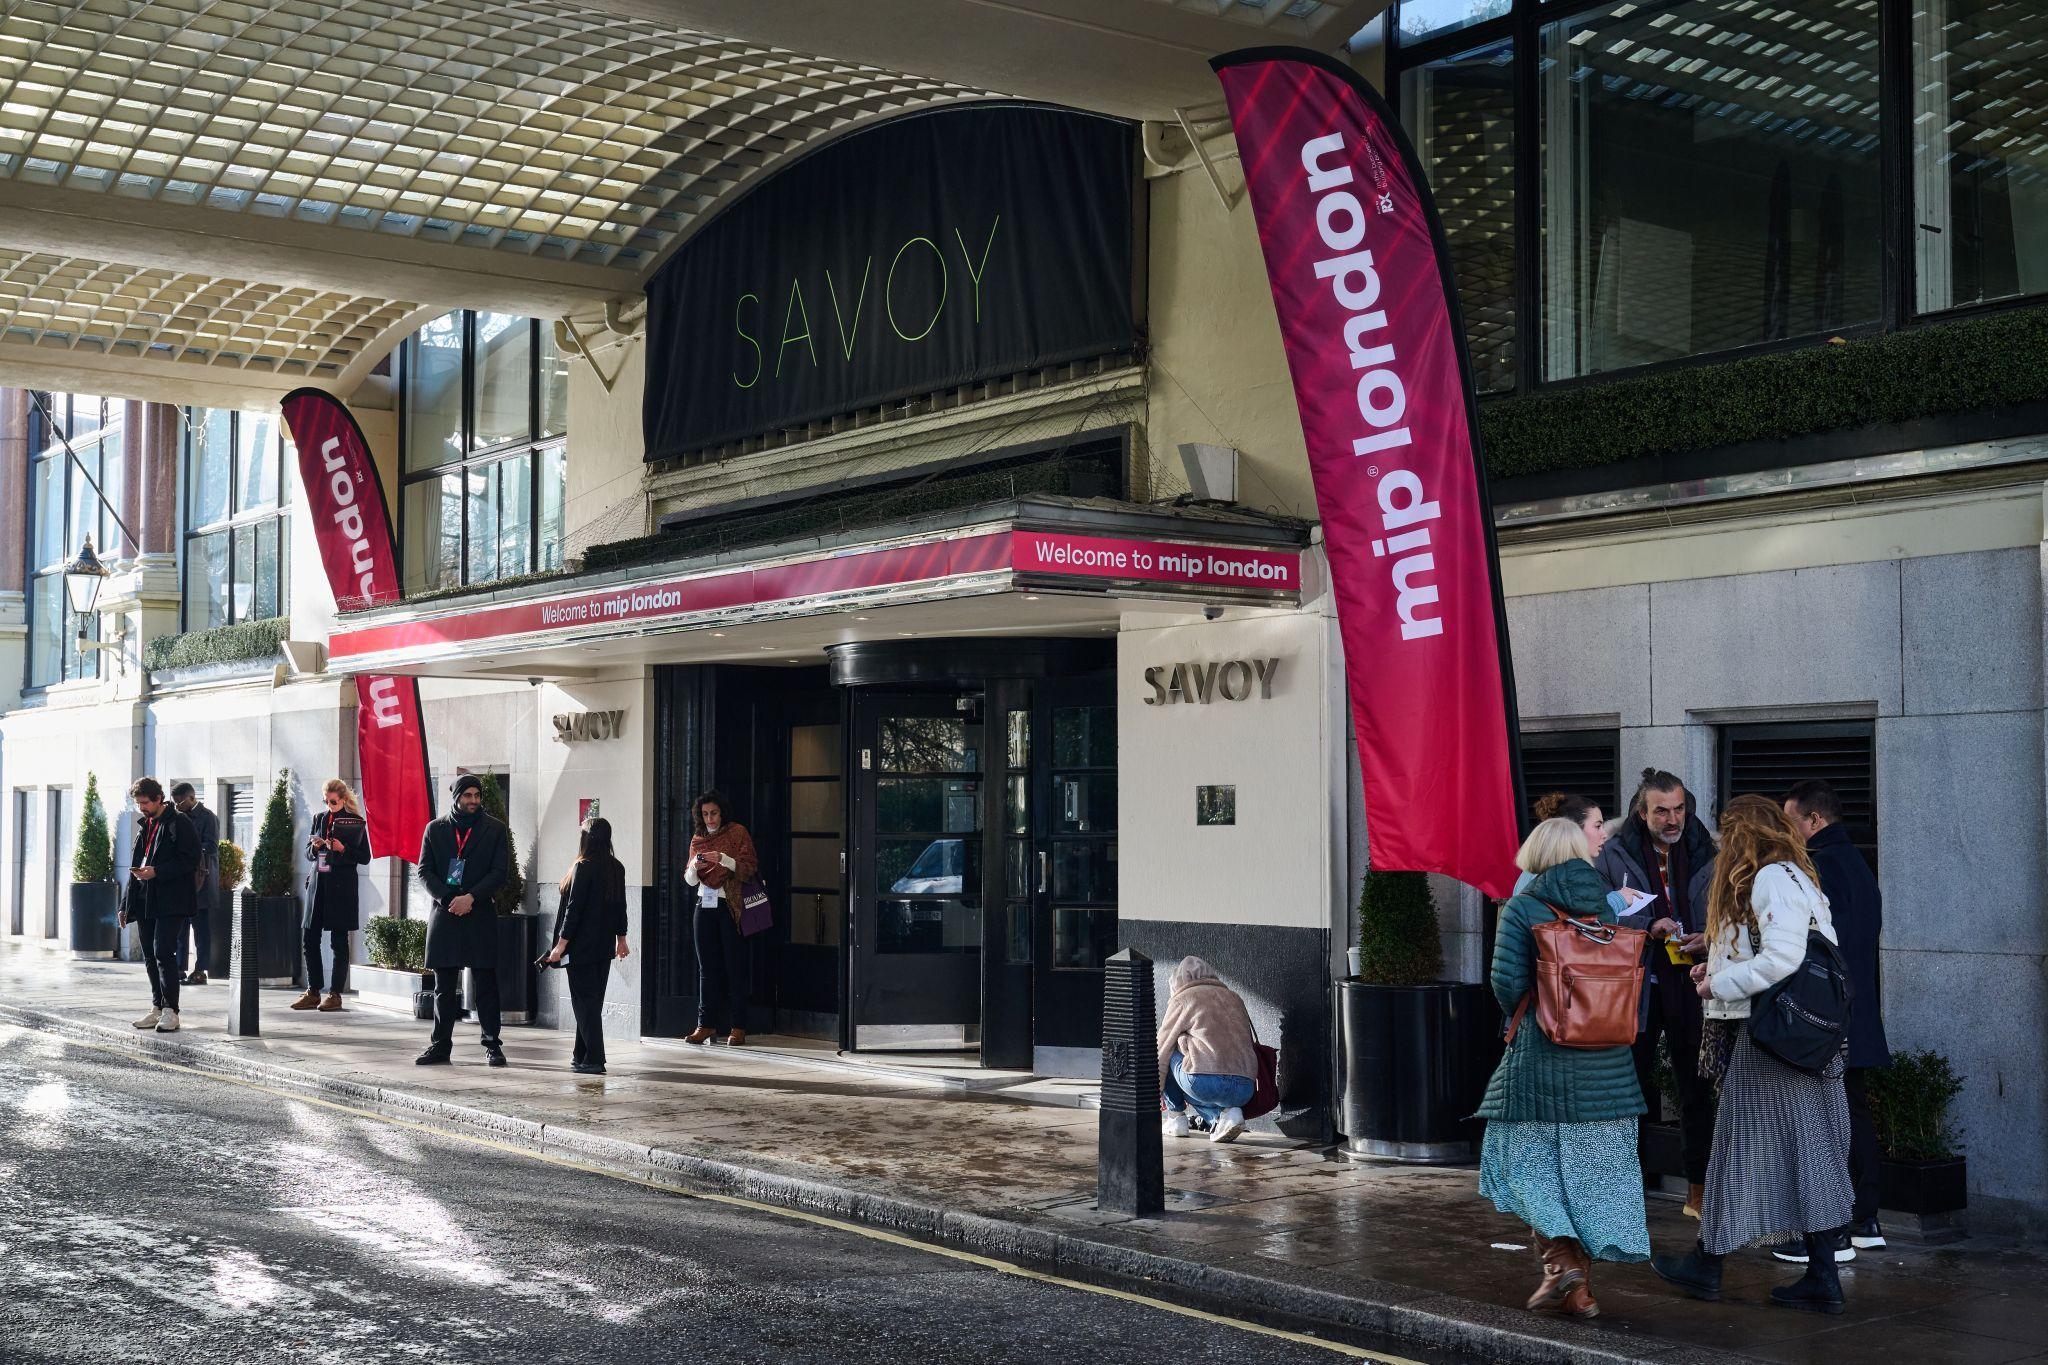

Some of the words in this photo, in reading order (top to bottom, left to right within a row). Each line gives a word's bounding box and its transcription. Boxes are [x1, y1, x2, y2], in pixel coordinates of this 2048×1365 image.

[1379, 192, 1394, 214] RX
[733, 214, 1000, 388] SAVOY
[1301, 131, 1413, 457] london
[321, 436, 375, 606] ondon
[1035, 540, 1127, 569] Welcome
[1132, 550, 1152, 570] to
[1207, 555, 1288, 581] london
[542, 603, 587, 624] Welcome
[590, 599, 601, 617] to
[631, 589, 681, 612] london
[1144, 658, 1280, 706] SAVOY
[552, 710, 624, 742] SAVOY
